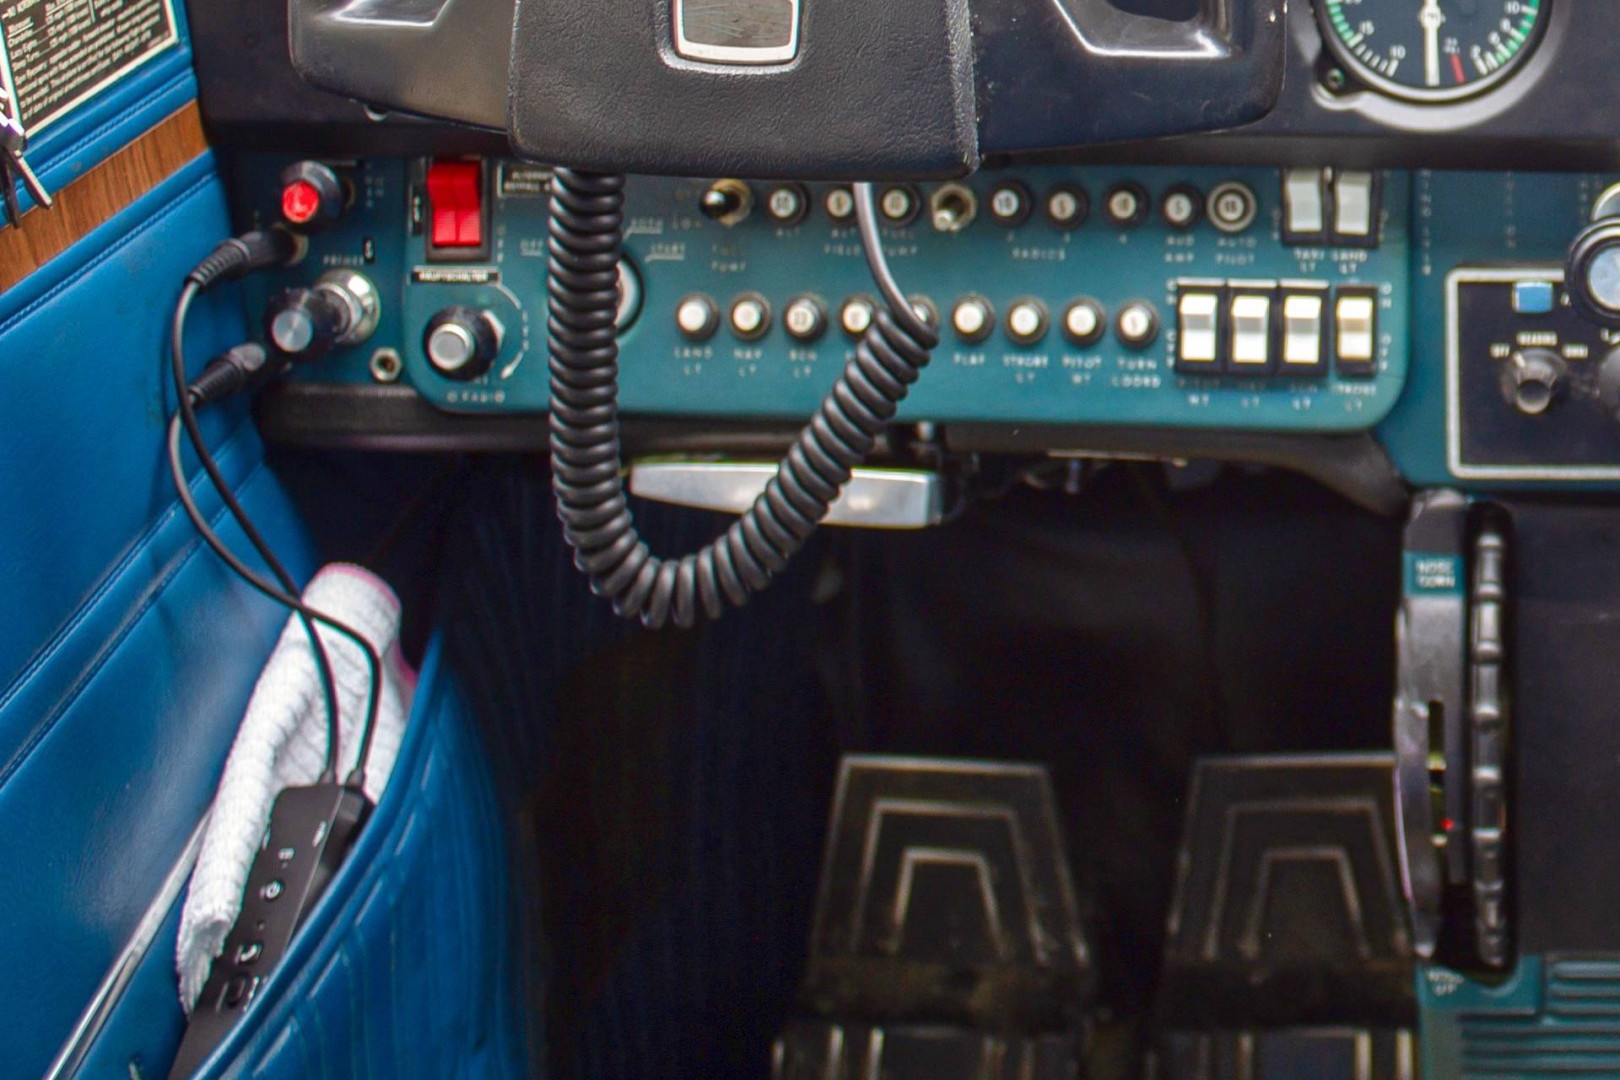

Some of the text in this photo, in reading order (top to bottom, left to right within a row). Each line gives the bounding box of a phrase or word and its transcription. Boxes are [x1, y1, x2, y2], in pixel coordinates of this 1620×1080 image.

[1506, 1, 1520, 14] 10
[1360, 21, 1374, 35] 15
[1389, 45, 1406, 59] 10
[1217, 237, 1256, 248] AUTO
[1012, 248, 1066, 260] RADIOS
[1165, 252, 1194, 263] AMP
[1216, 254, 1255, 265] PILOT
[1293, 250, 1324, 261] TAXI
[1331, 251, 1368, 262] LAND
[673, 348, 713, 359] LAND
[733, 348, 762, 359] NAV
[953, 353, 985, 364] FLAP
[1003, 354, 1049, 367] STROBE
[1062, 356, 1102, 368] PITOT
[1117, 358, 1158, 370] TURN
[1112, 376, 1161, 388] COORD
[1416, 560, 1454, 575] NOSE
[1416, 575, 1456, 589] DOWN
